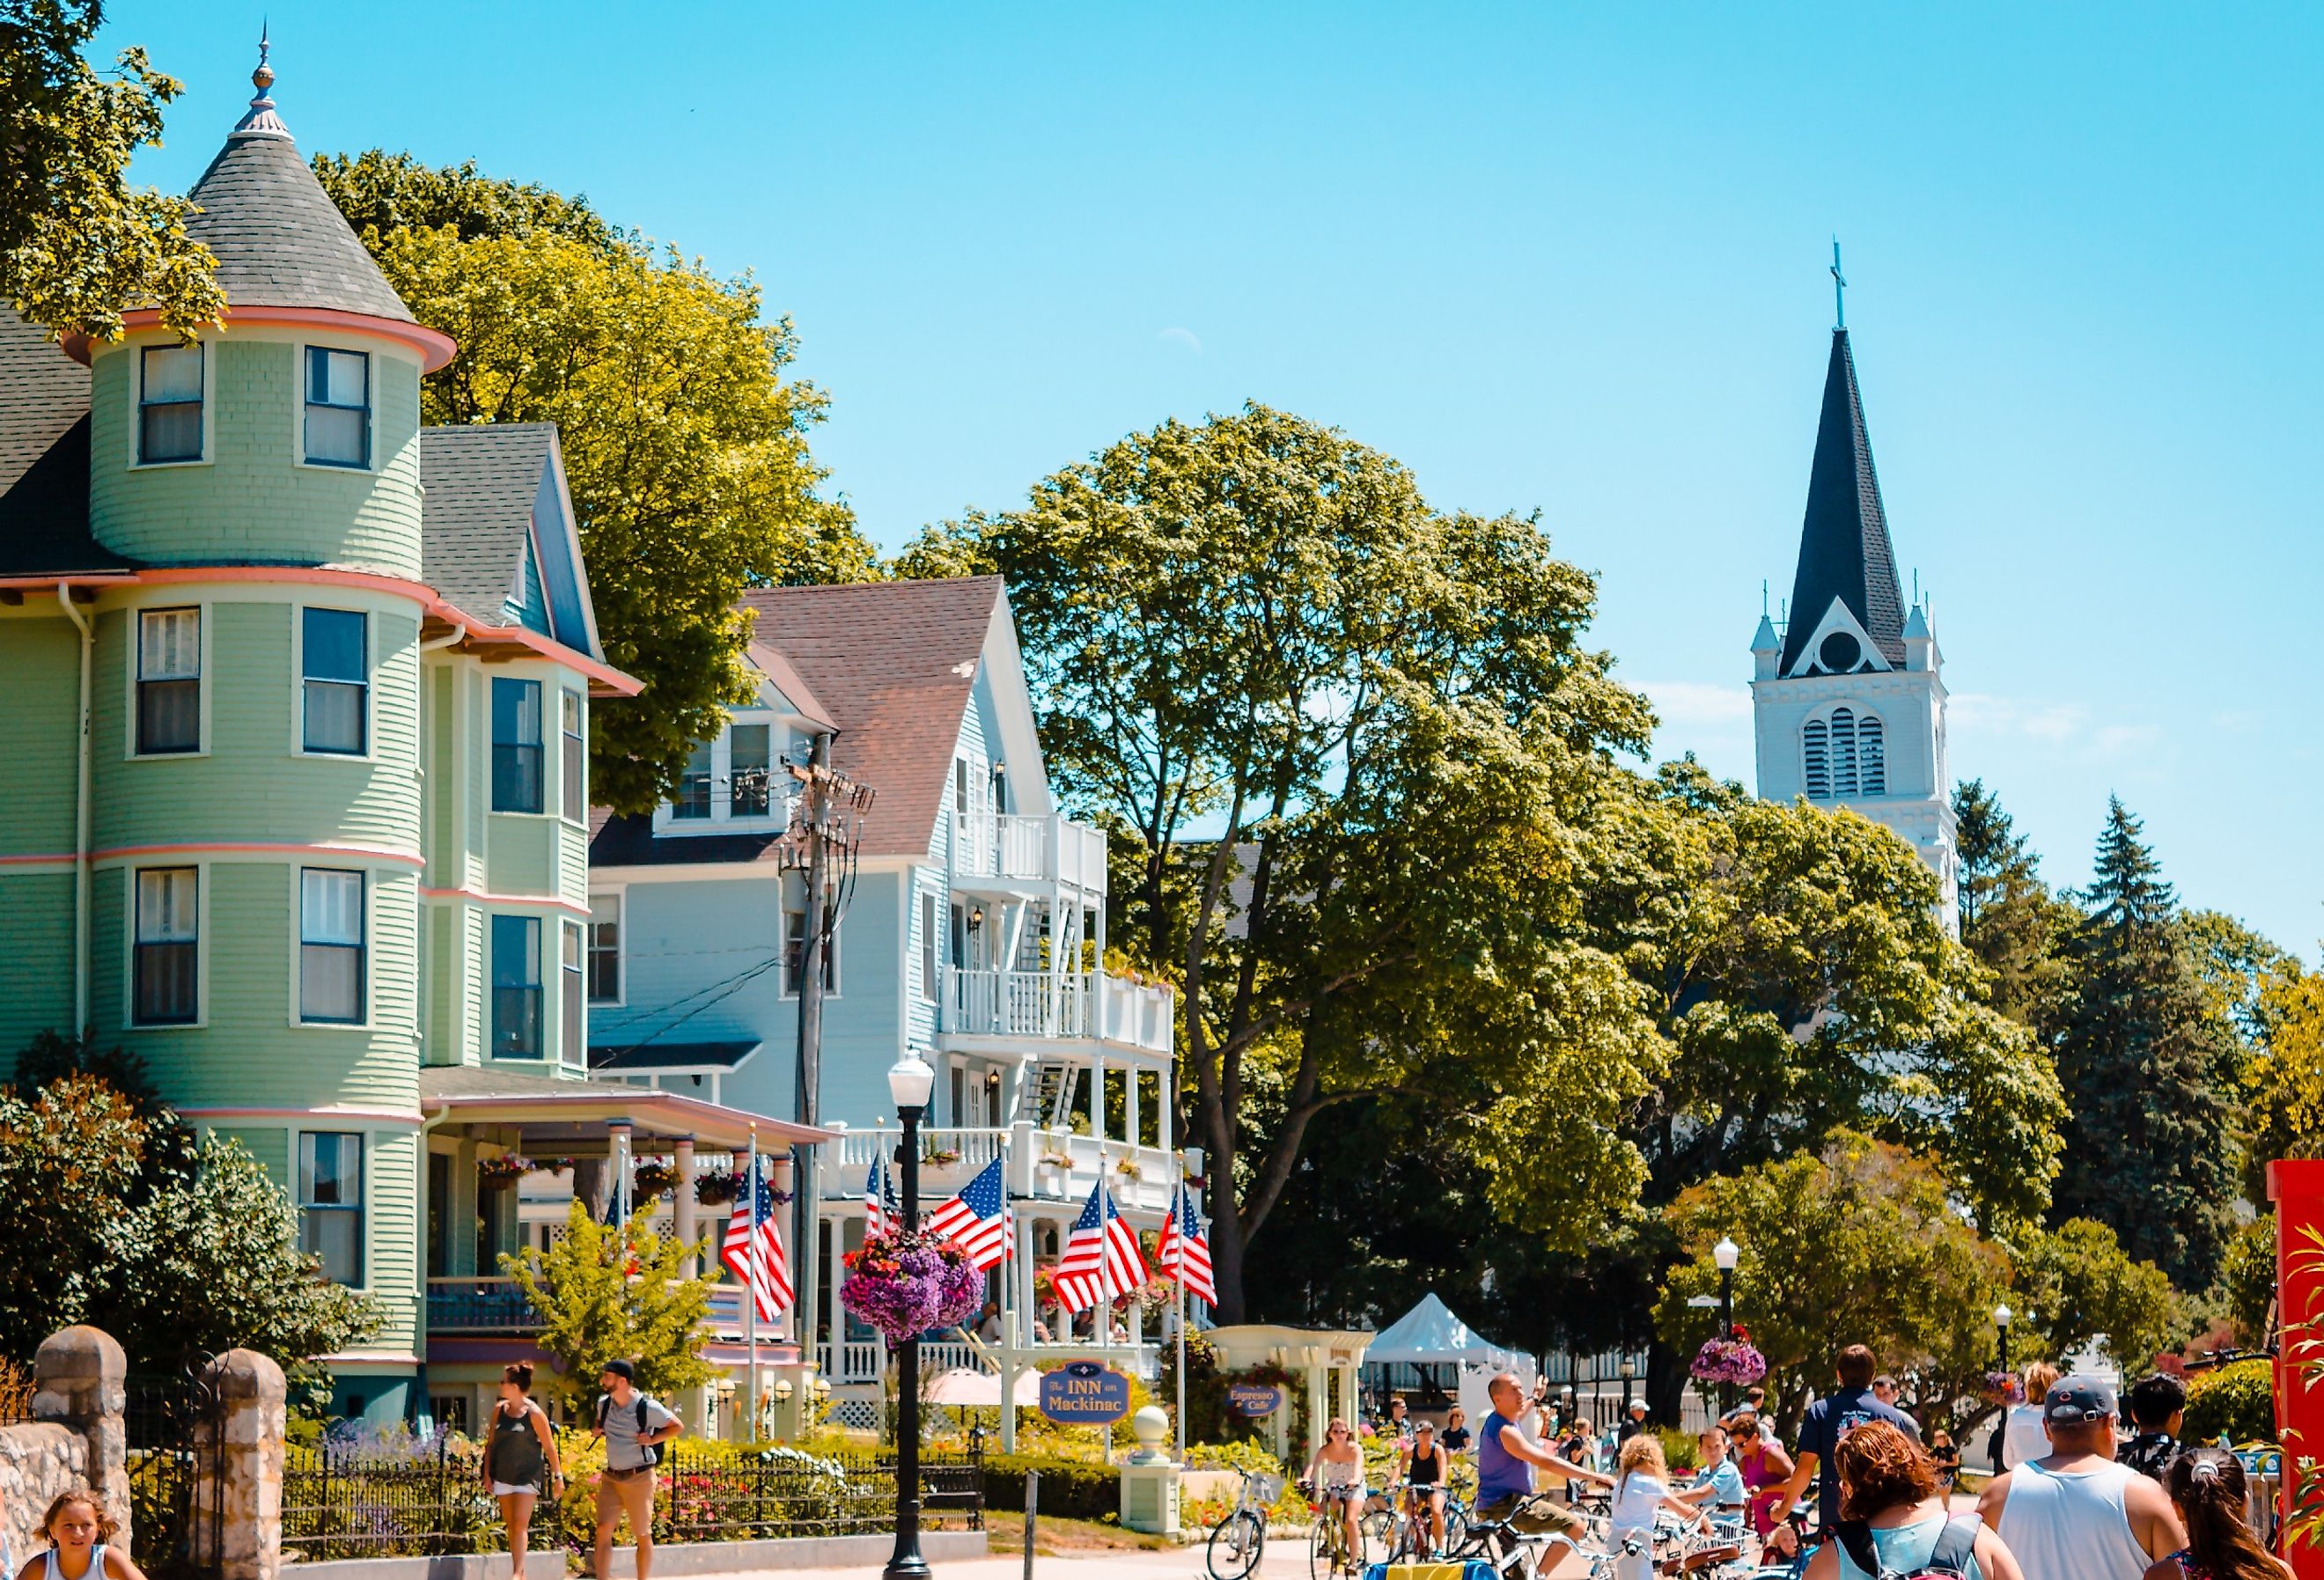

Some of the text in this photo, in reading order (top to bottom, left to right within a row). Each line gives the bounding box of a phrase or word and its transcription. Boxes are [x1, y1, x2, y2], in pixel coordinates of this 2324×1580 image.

[1068, 1380, 1101, 1394] INN
[1231, 1390, 1274, 1401] Espresso
[1048, 1396, 1122, 1411] Mackinac
